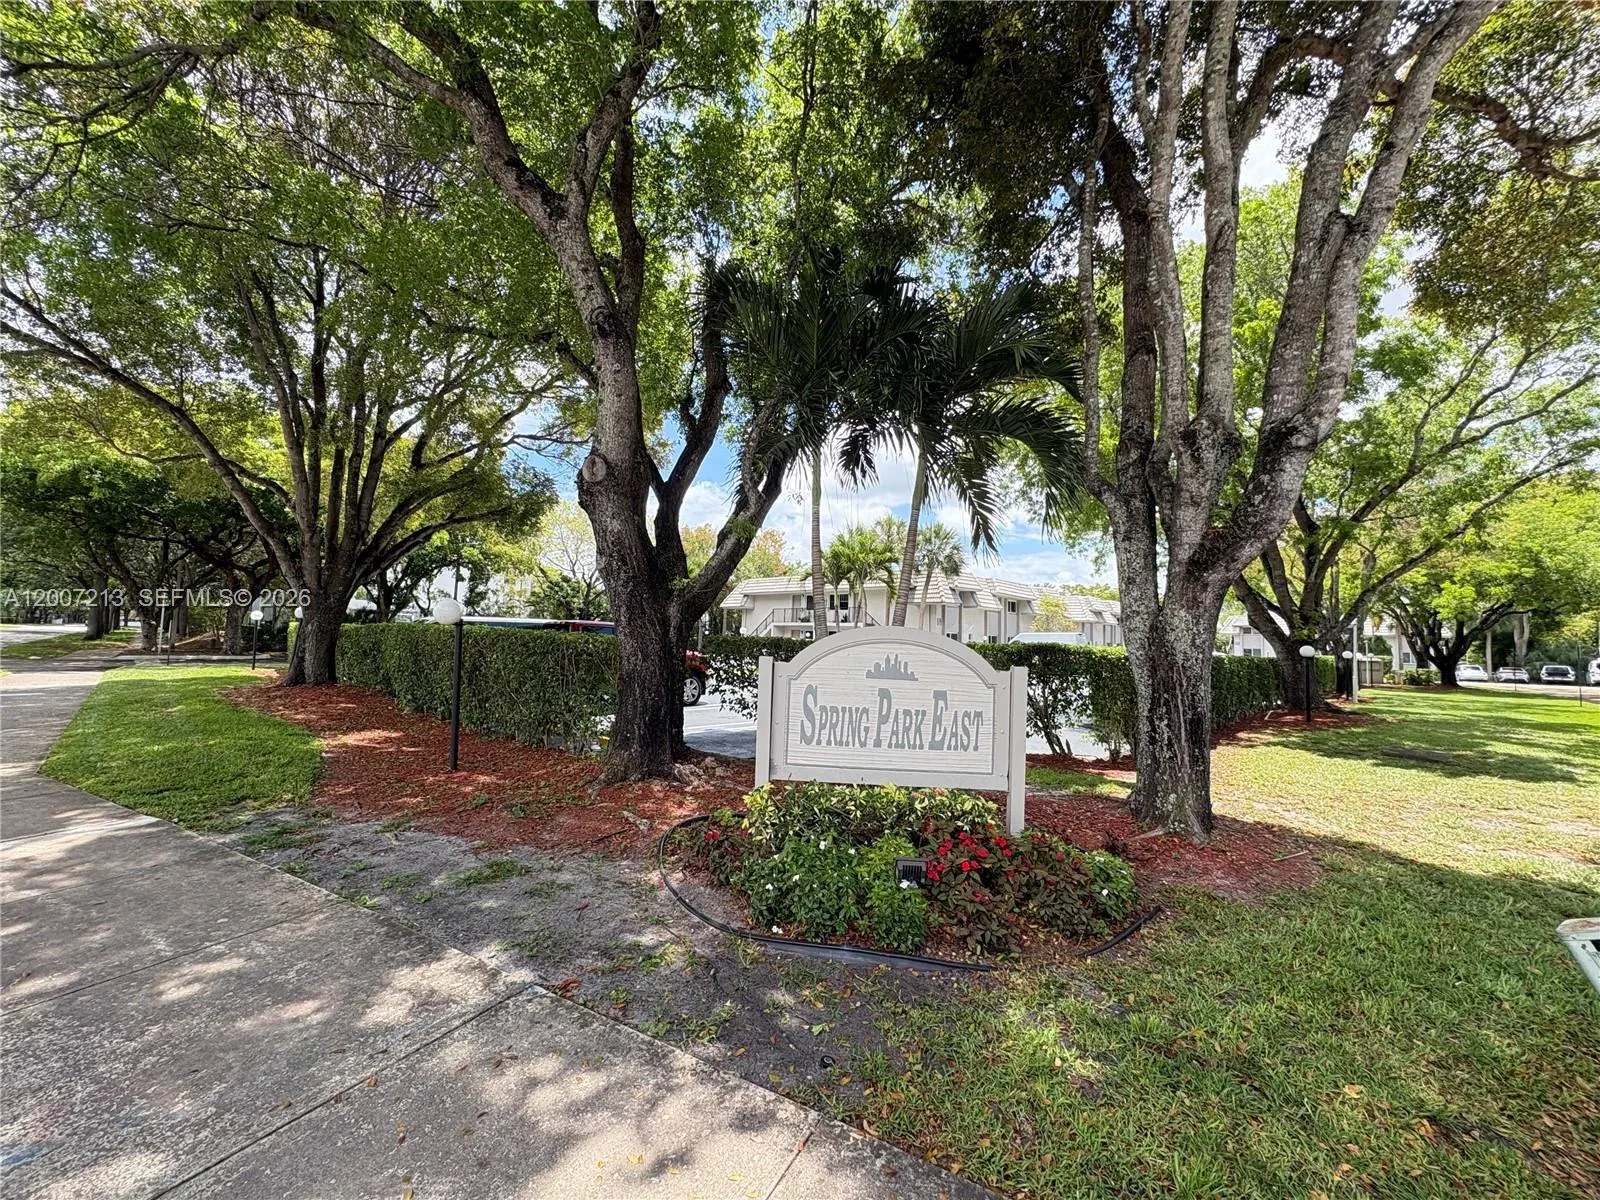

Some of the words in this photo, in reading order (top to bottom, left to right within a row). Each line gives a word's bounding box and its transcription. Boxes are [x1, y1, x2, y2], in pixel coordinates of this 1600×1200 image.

[800, 684, 870, 748] SPRING
[873, 687, 927, 750] PARK
[928, 690, 983, 752] EAST
